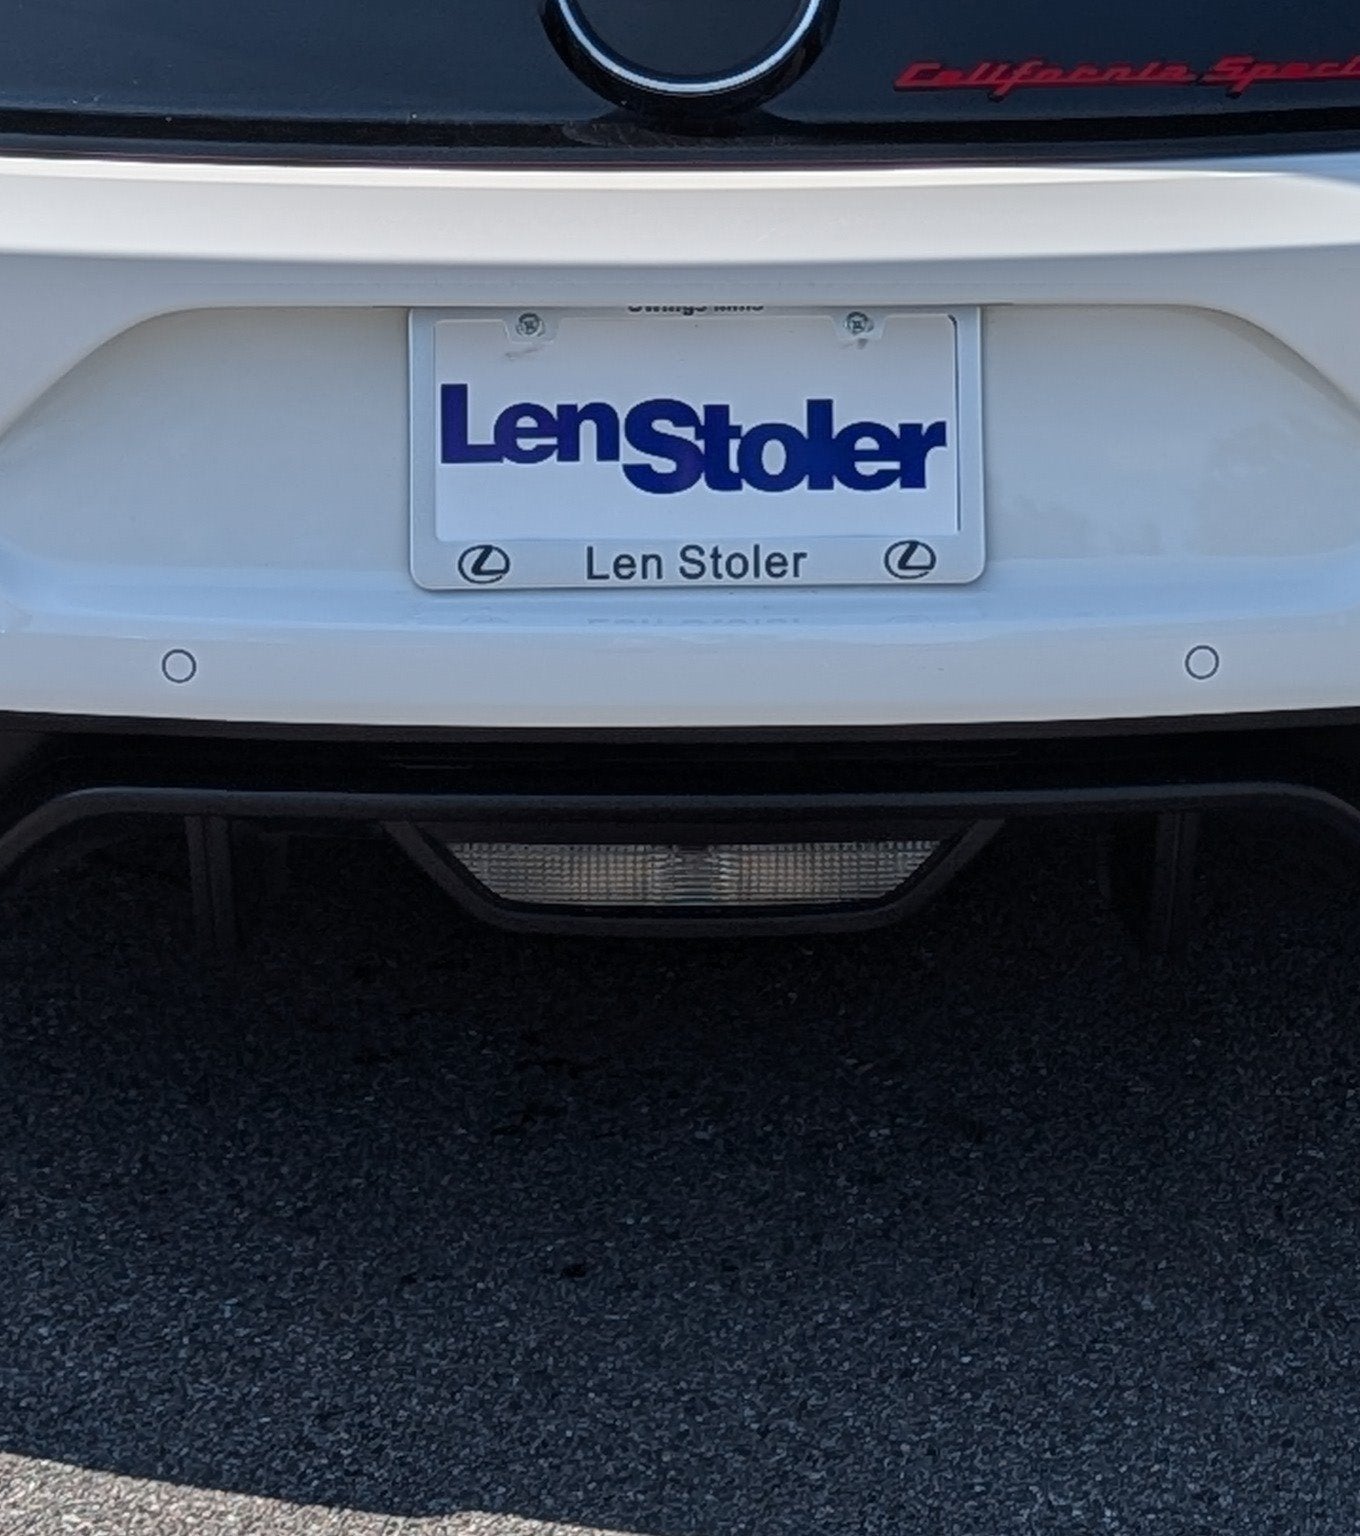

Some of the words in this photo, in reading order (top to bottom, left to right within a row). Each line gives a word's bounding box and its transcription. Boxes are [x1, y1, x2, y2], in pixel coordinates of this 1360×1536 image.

[893, 60, 1197, 103] California
[587, 545, 664, 581] Len
[678, 544, 808, 581] Stoler
